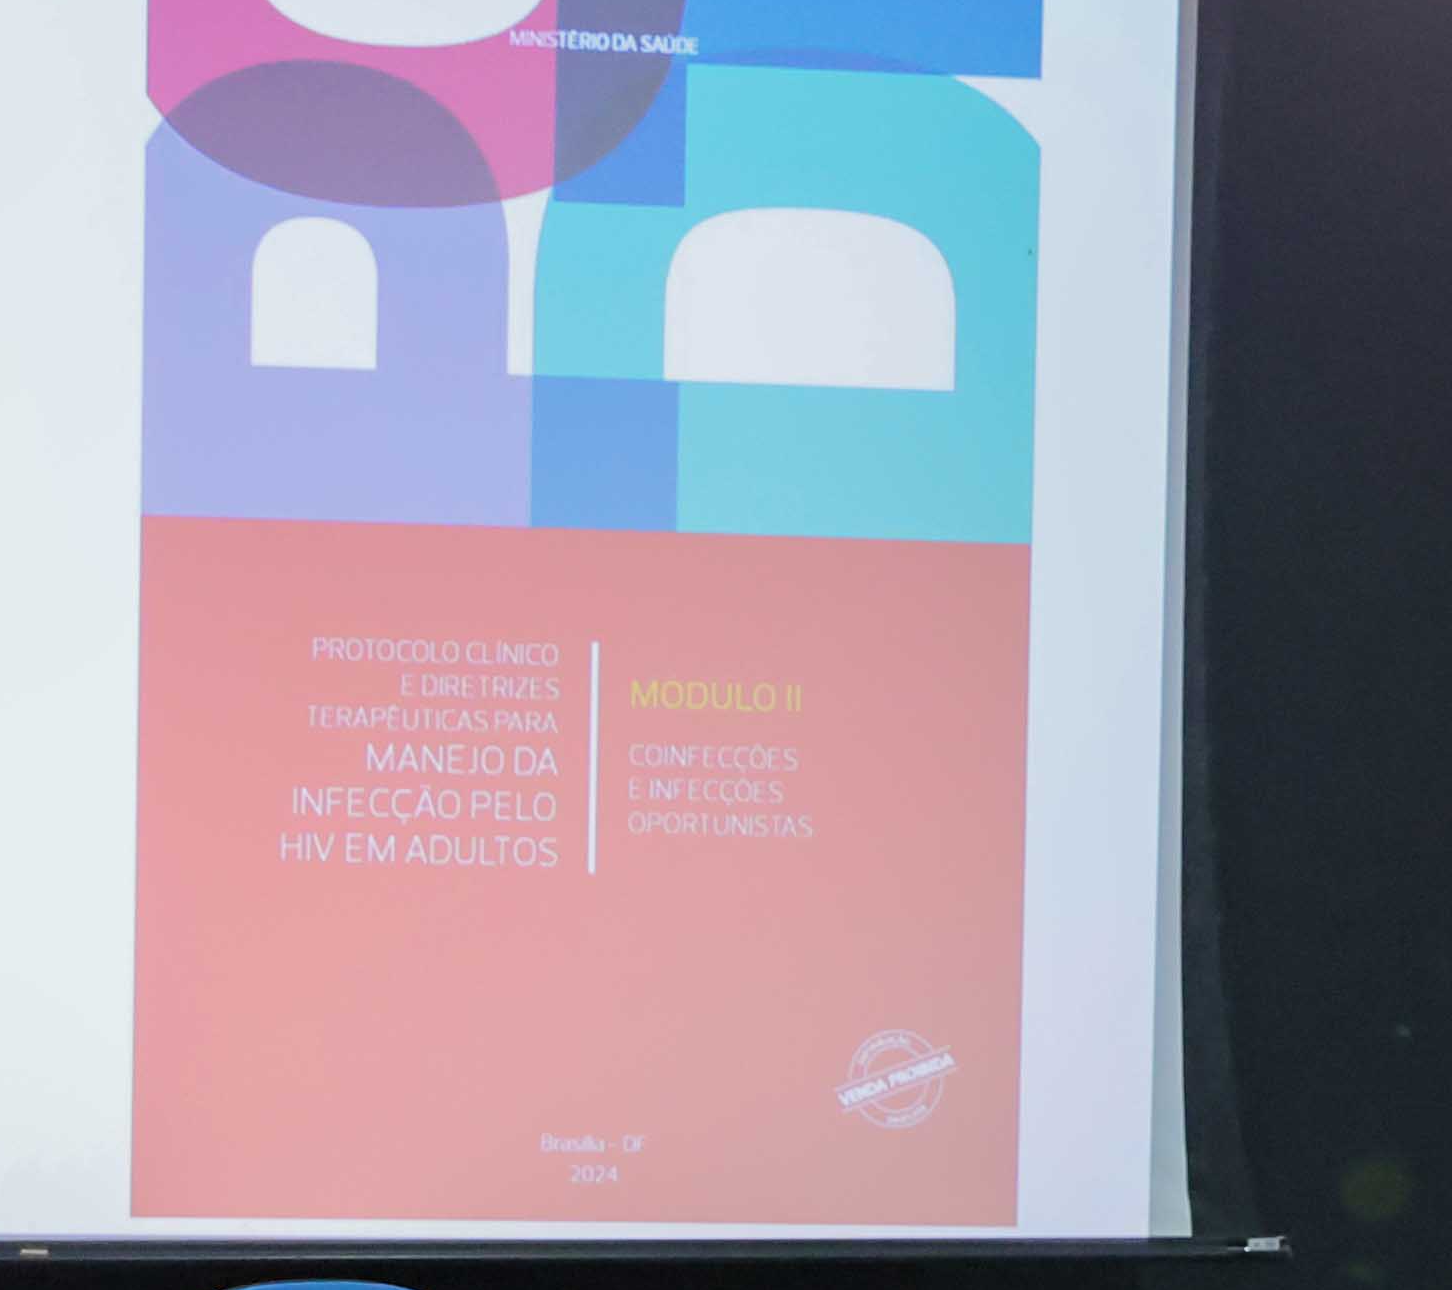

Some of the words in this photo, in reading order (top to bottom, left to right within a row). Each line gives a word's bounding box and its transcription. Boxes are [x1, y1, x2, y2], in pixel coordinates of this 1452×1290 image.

[612, 32, 637, 53] DA
[311, 635, 460, 663] PROTOCOLO
[400, 672, 415, 697] E
[420, 673, 561, 700] DIRETRIZES
[787, 683, 803, 713] II
[493, 709, 559, 734] PARA
[365, 742, 505, 775] MANEJO
[513, 744, 559, 777] DA
[628, 776, 640, 801] E
[291, 784, 462, 826] INFECÇÃO
[470, 789, 558, 823] PELO
[627, 810, 815, 838] OPORTUNISTAS
[279, 831, 336, 863] HIV
[344, 832, 396, 864] EM
[404, 833, 560, 868] ADULTOS
[570, 1163, 619, 1184] 2024
